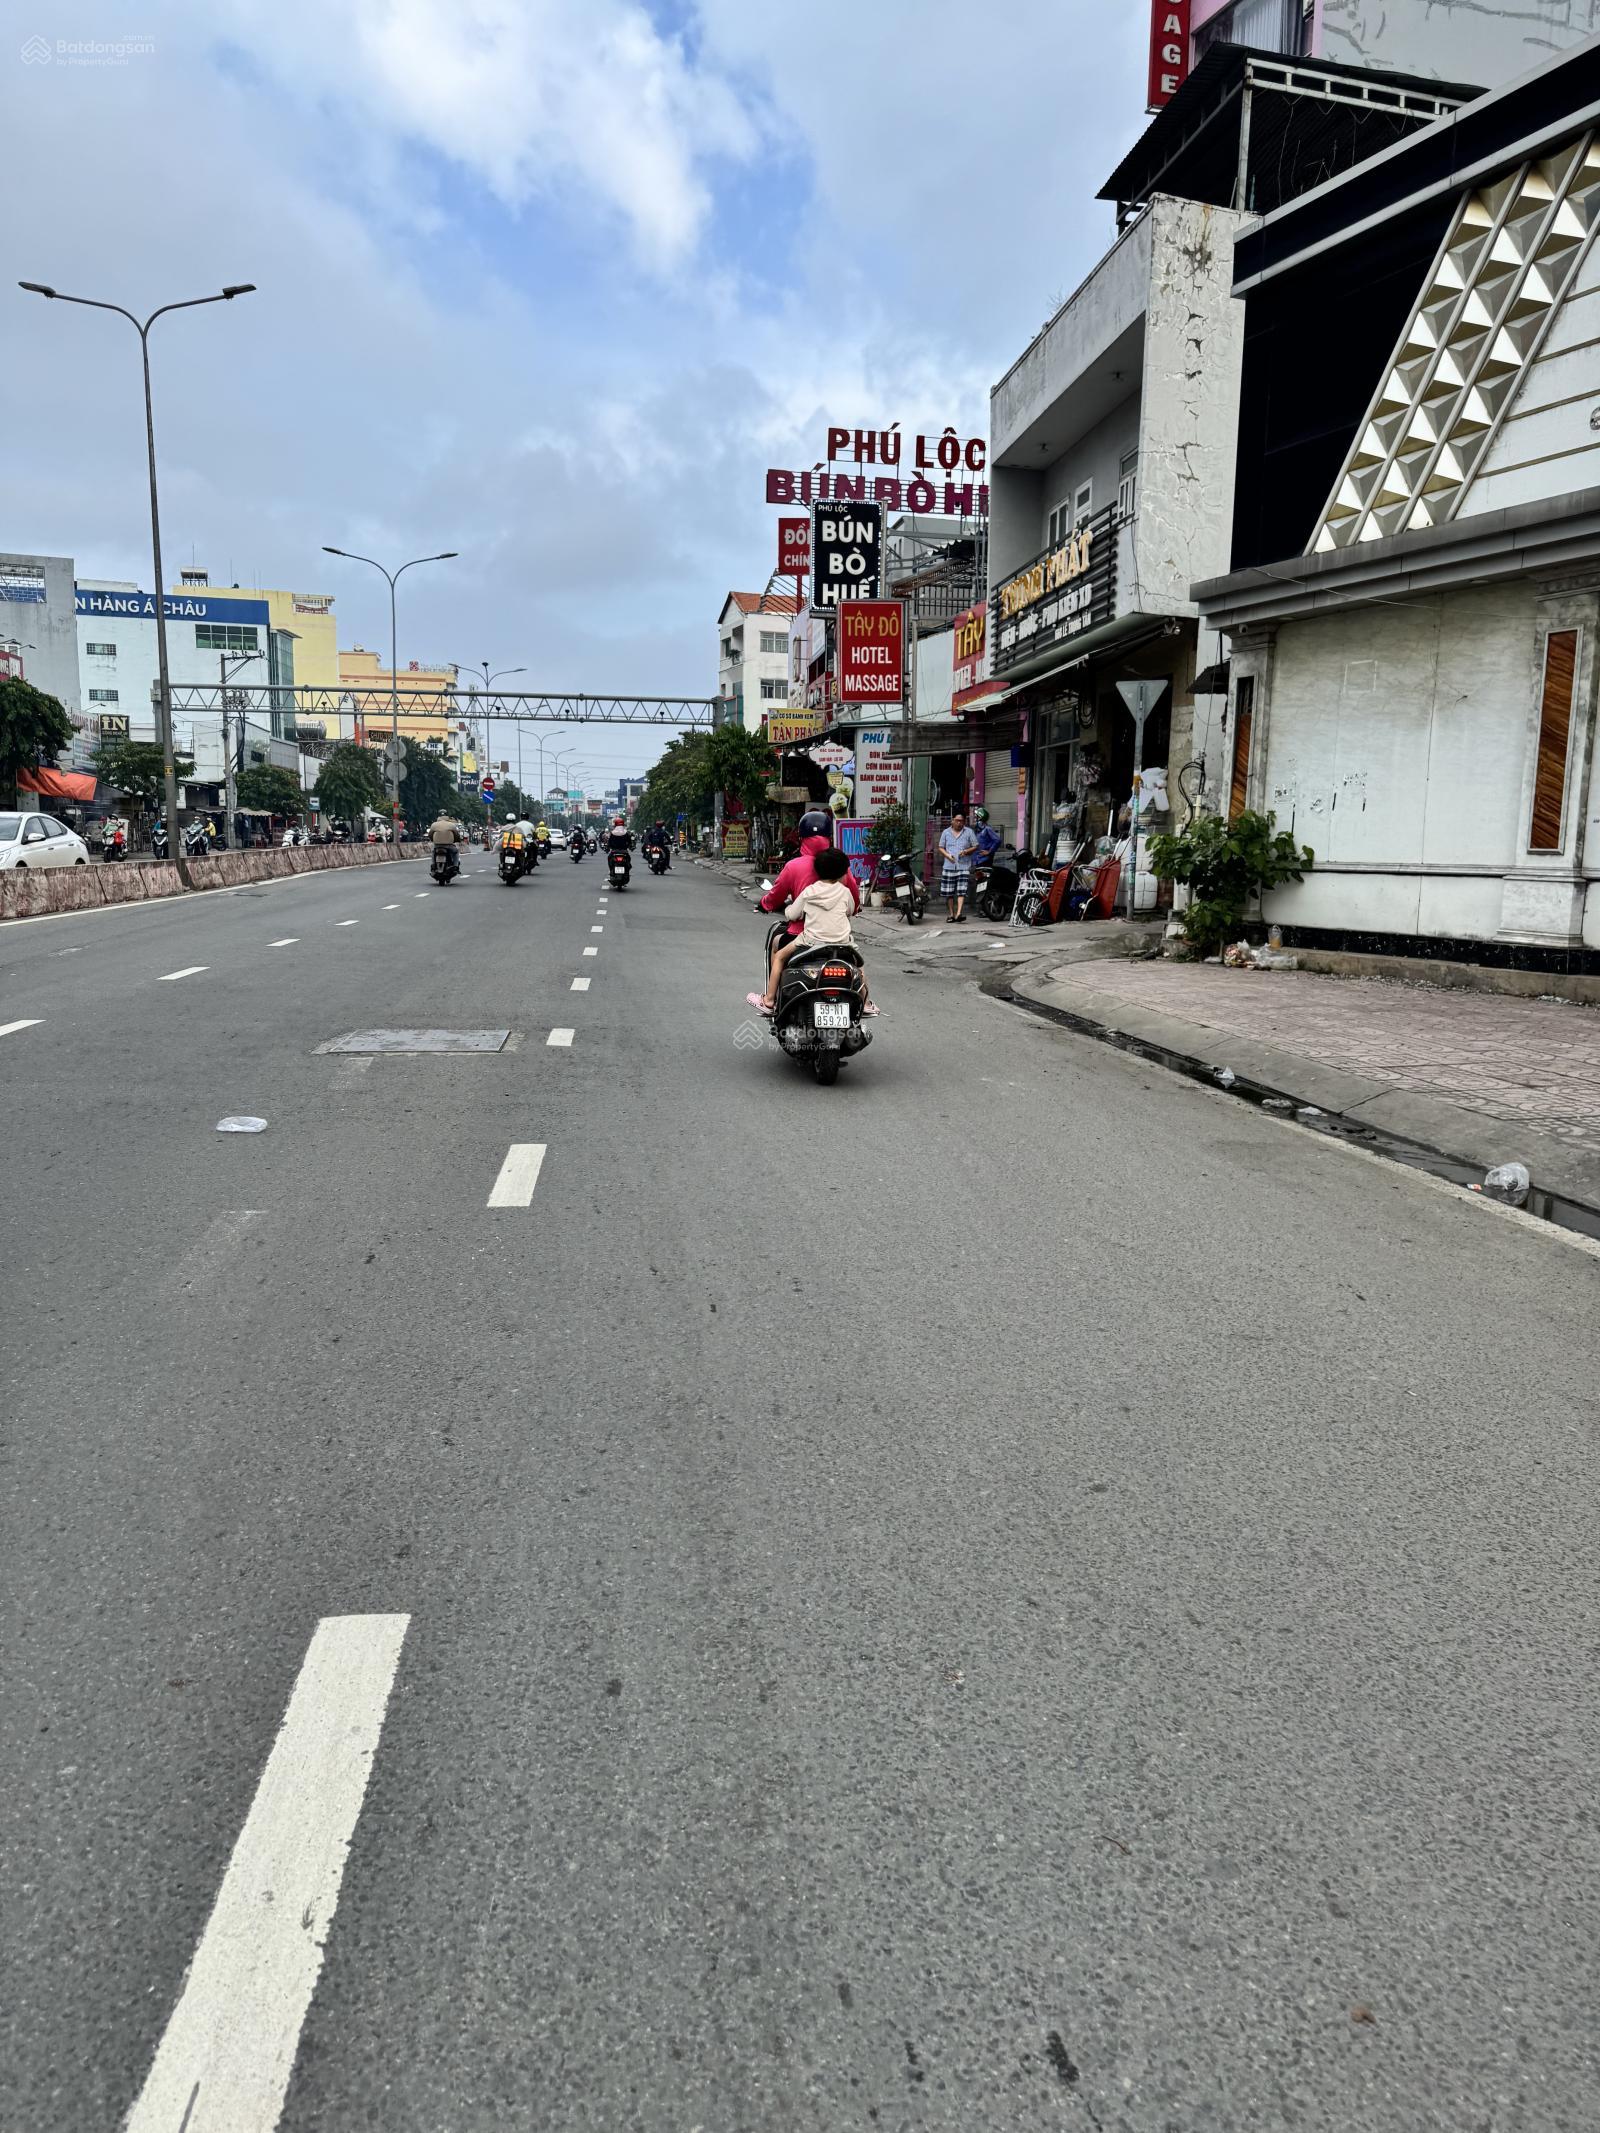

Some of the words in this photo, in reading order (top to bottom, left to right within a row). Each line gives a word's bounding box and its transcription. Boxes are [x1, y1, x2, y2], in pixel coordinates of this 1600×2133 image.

[828, 422, 901, 465] PHÚ
[916, 427, 986, 477] LỘC
[766, 463, 866, 505] BÚN
[874, 471, 936, 514] BÒ
[834, 503, 848, 513] LỘC
[822, 515, 873, 544] BÚN
[829, 547, 866, 575] BÒ
[822, 576, 876, 604] HUẾ
[90, 597, 140, 613] HÀNG
[143, 597, 155, 614] Á
[163, 599, 207, 617] CHÂU
[845, 610, 875, 637] TÂY
[878, 610, 900, 636] ĐÔ
[956, 611, 984, 660] TÂY
[851, 646, 893, 664] HOTEL
[845, 674, 899, 692] MASSAGE
[773, 722, 792, 741] TÂN
[862, 730, 884, 743] PHÚ
[817, 1015, 848, 1026] 859.20
